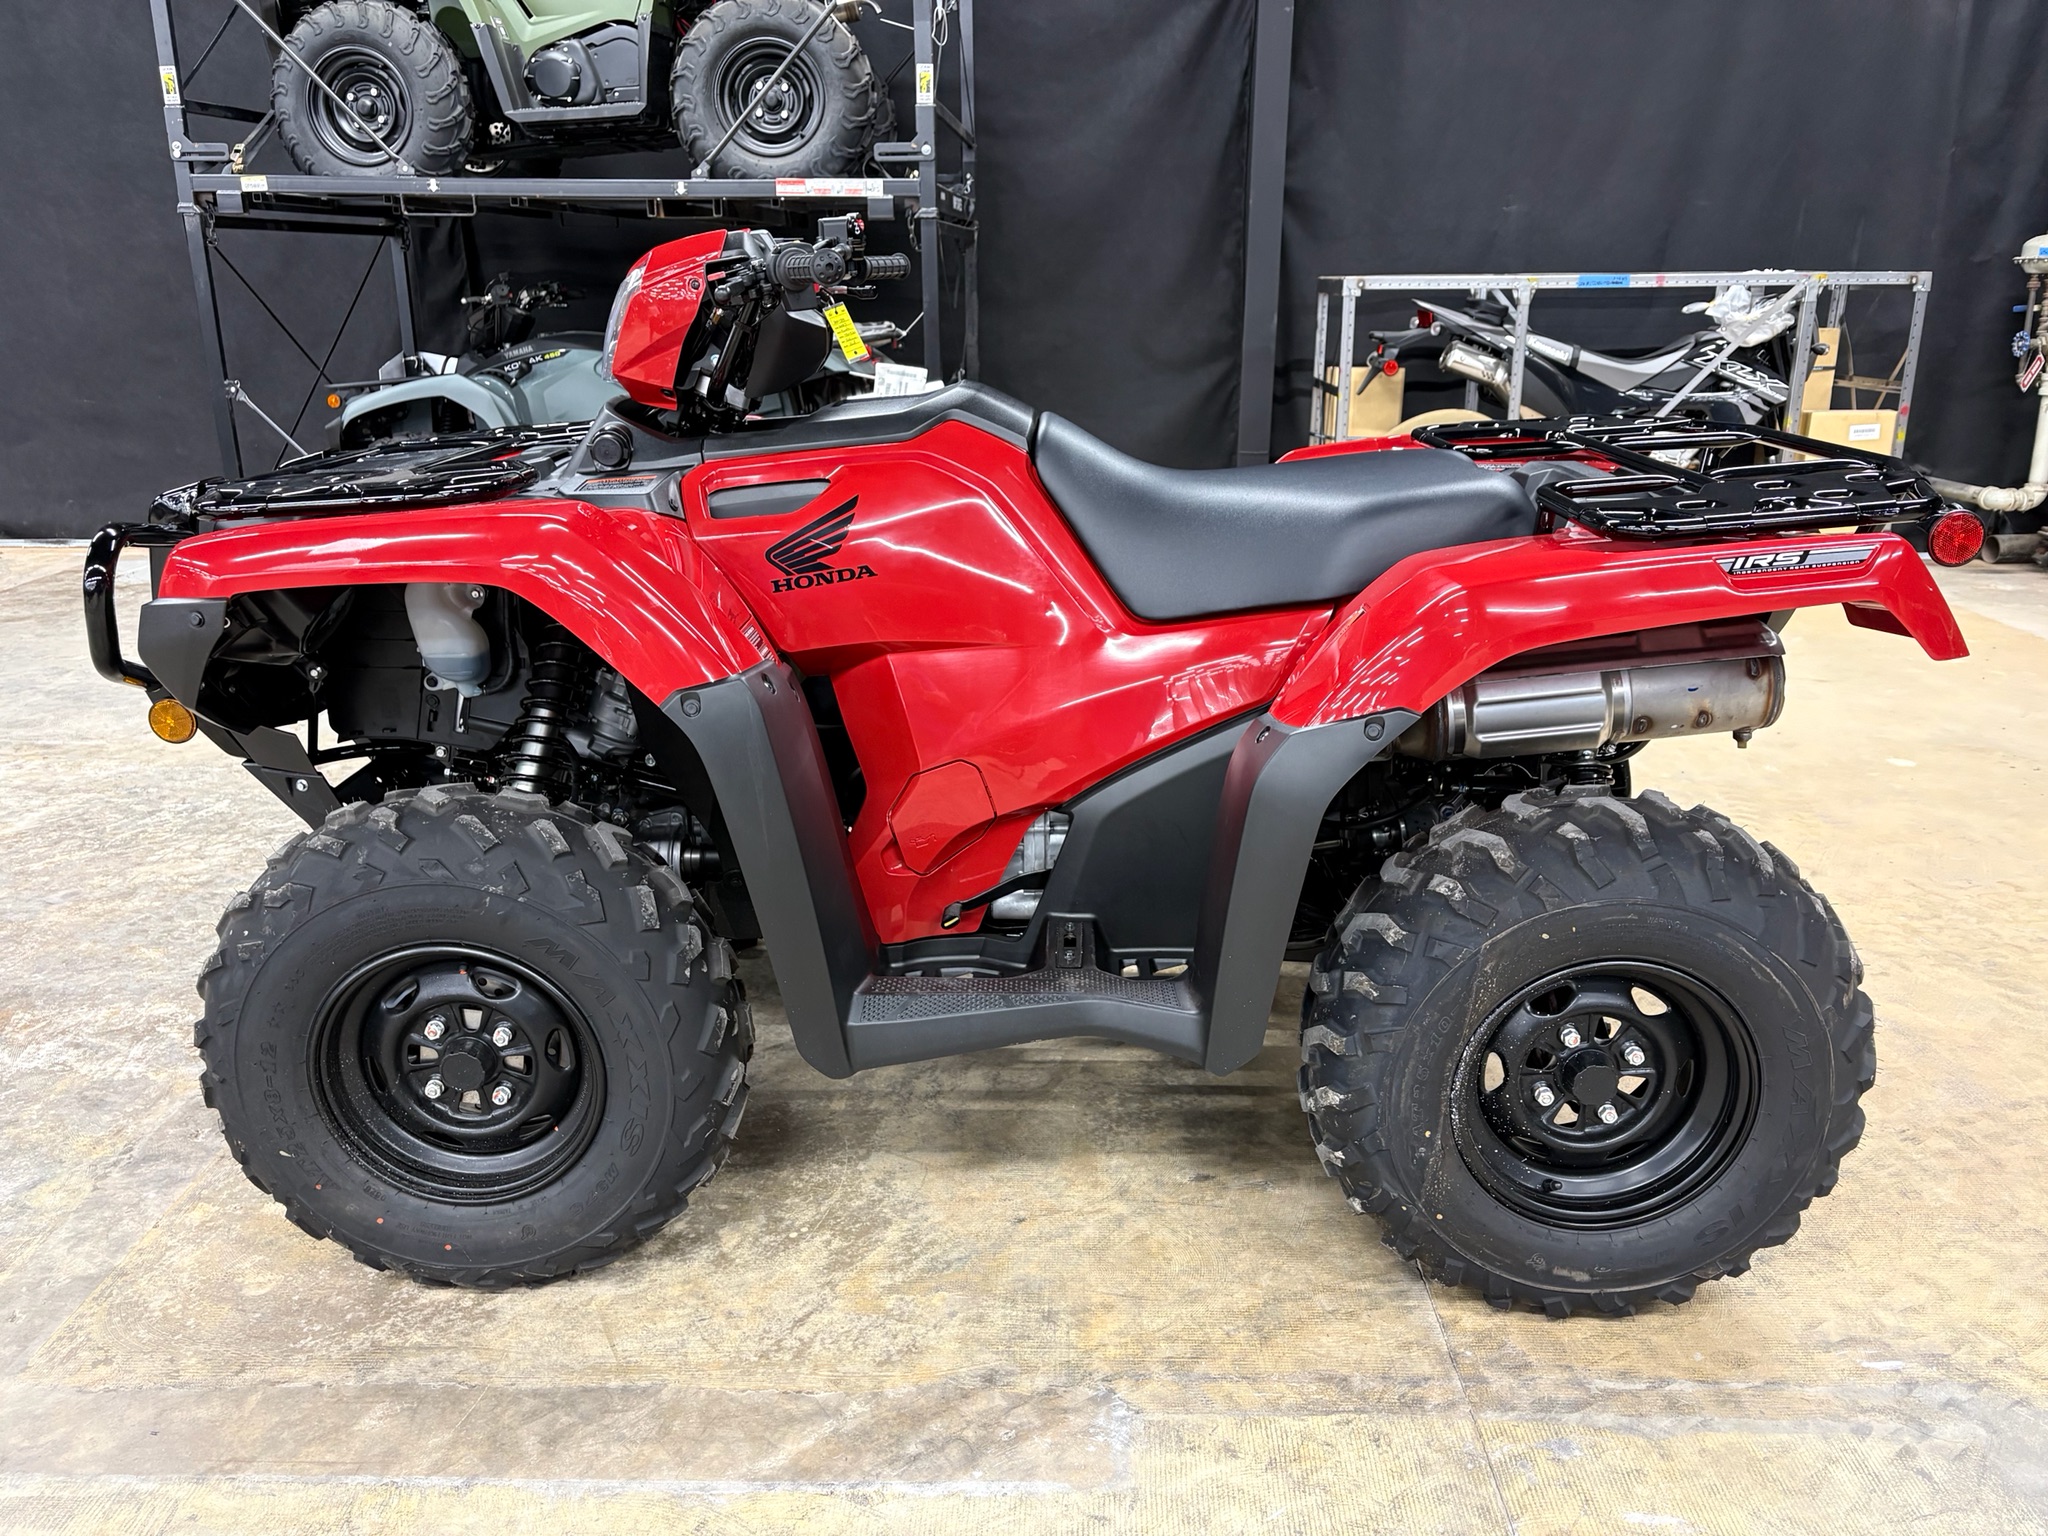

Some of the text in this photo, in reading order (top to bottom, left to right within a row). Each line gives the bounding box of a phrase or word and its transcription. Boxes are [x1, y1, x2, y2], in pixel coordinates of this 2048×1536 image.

[504, 345, 534, 359] YAMAHA
[503, 354, 544, 373] KOAK
[1732, 551, 1805, 570] IRS
[1733, 566, 1788, 575] INDEPENDENT
[1811, 560, 1861, 569] SUSPENSION
[770, 564, 878, 593] HONDA
[522, 935, 651, 1158] MAXXIS
